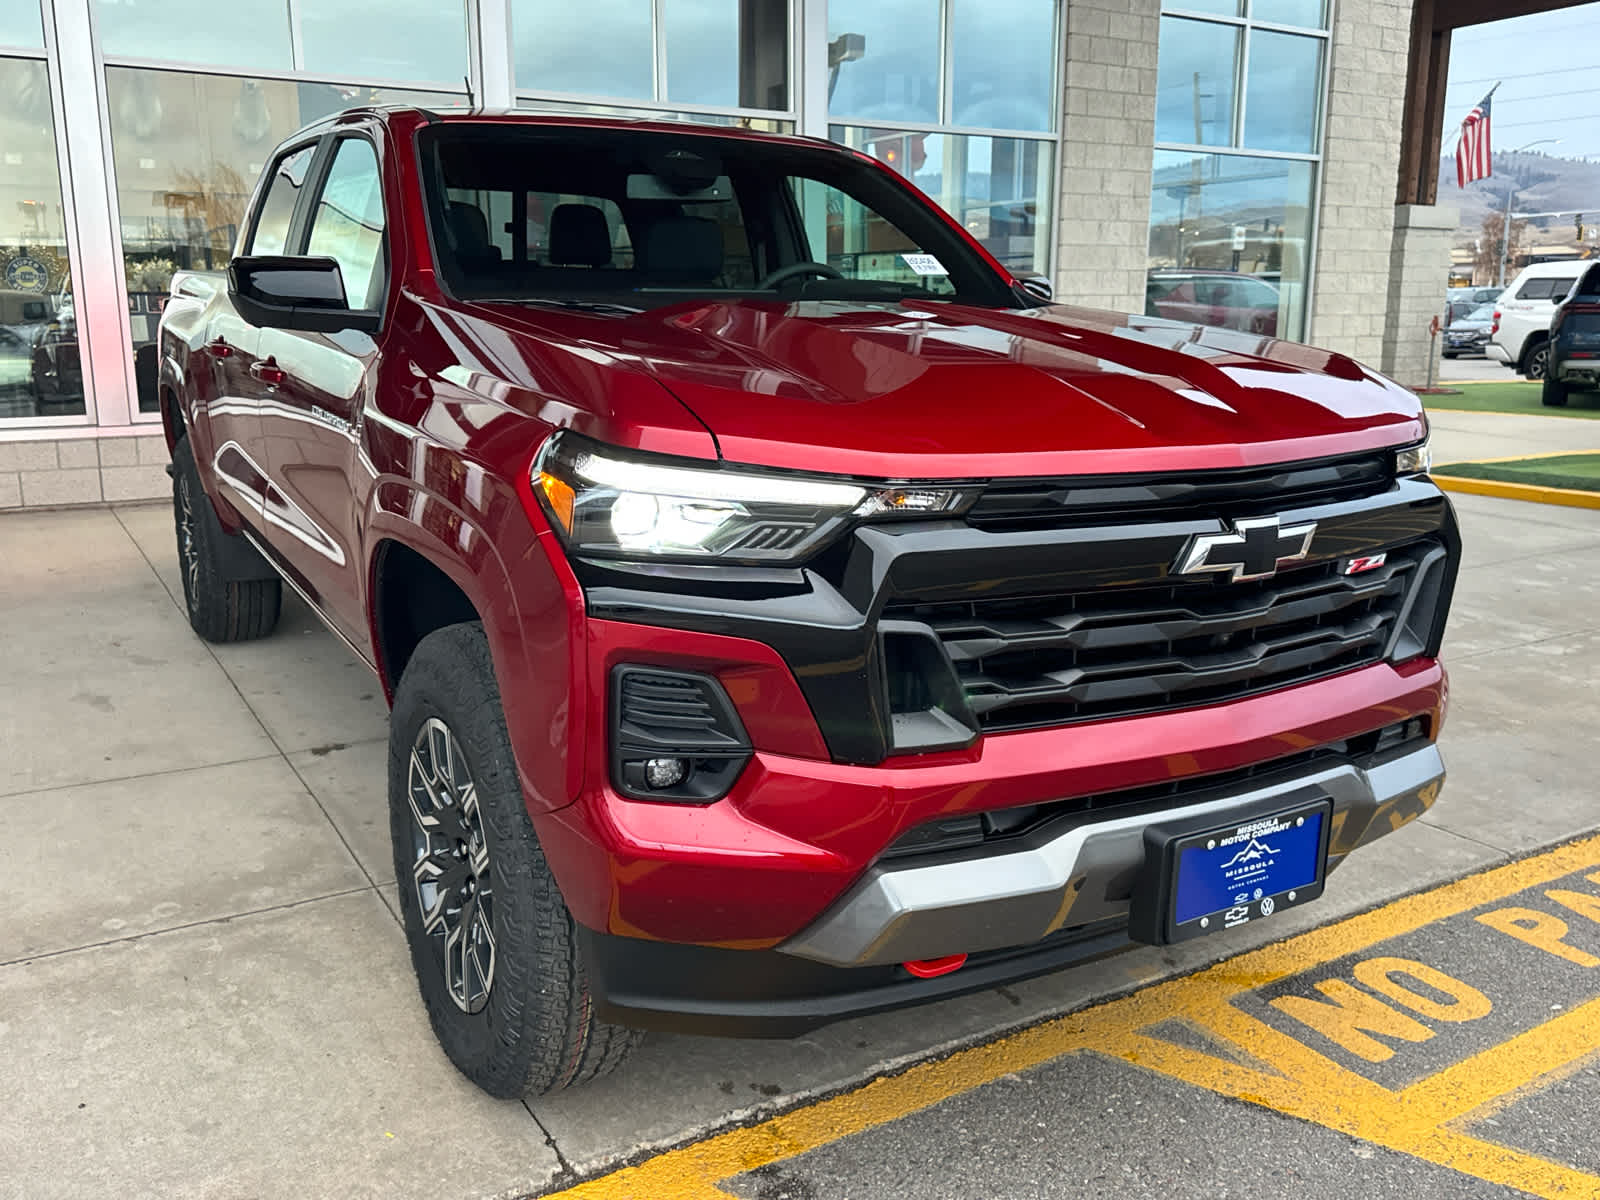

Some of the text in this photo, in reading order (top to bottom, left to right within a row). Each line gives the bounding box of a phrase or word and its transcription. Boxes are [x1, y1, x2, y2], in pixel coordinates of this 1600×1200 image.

[1220, 821, 1292, 847] MOTOR COMPANY
[1236, 818, 1279, 835] MISSOULA
[1225, 859, 1275, 878] MISSOULA
[1268, 957, 1492, 1063] NO
